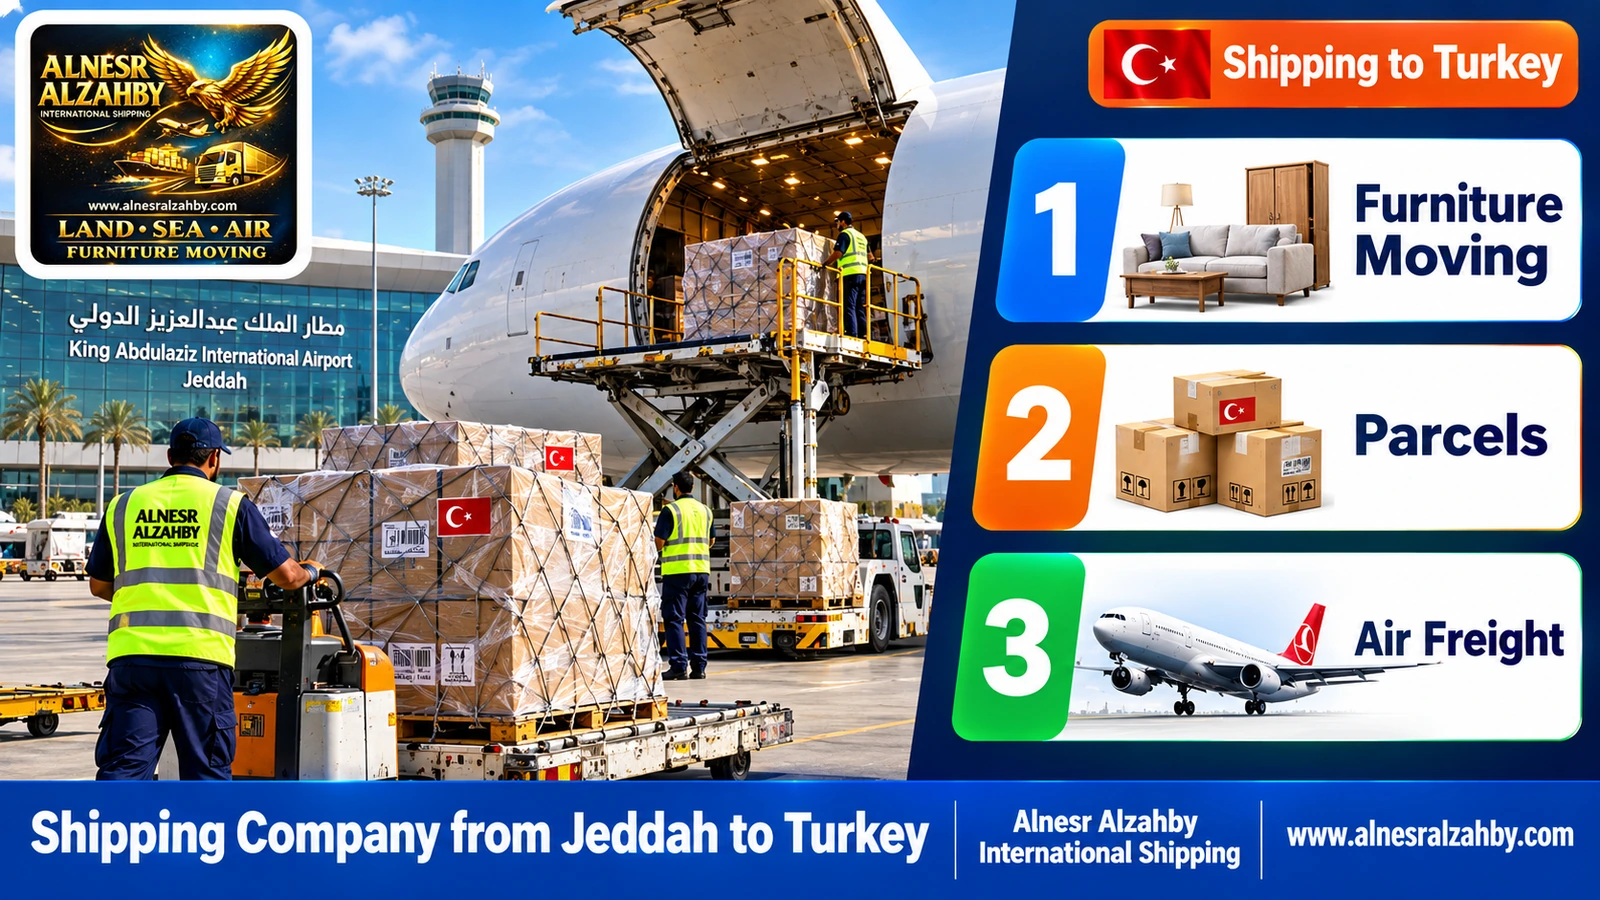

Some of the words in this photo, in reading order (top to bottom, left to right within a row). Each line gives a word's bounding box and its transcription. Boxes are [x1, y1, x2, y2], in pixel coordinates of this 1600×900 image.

[69, 303, 140, 335] الدولي
[145, 308, 238, 334] عبدالعزيز
[244, 311, 298, 334] الملك
[302, 314, 345, 338] مطار
[69, 340, 111, 363] King
[114, 344, 198, 363] Abdulaziz
[202, 346, 299, 367] International
[302, 350, 353, 371] Airport
[182, 370, 248, 390] Jeddah
[134, 508, 199, 523] ALNESR
[132, 525, 201, 539] ALZAHBY
